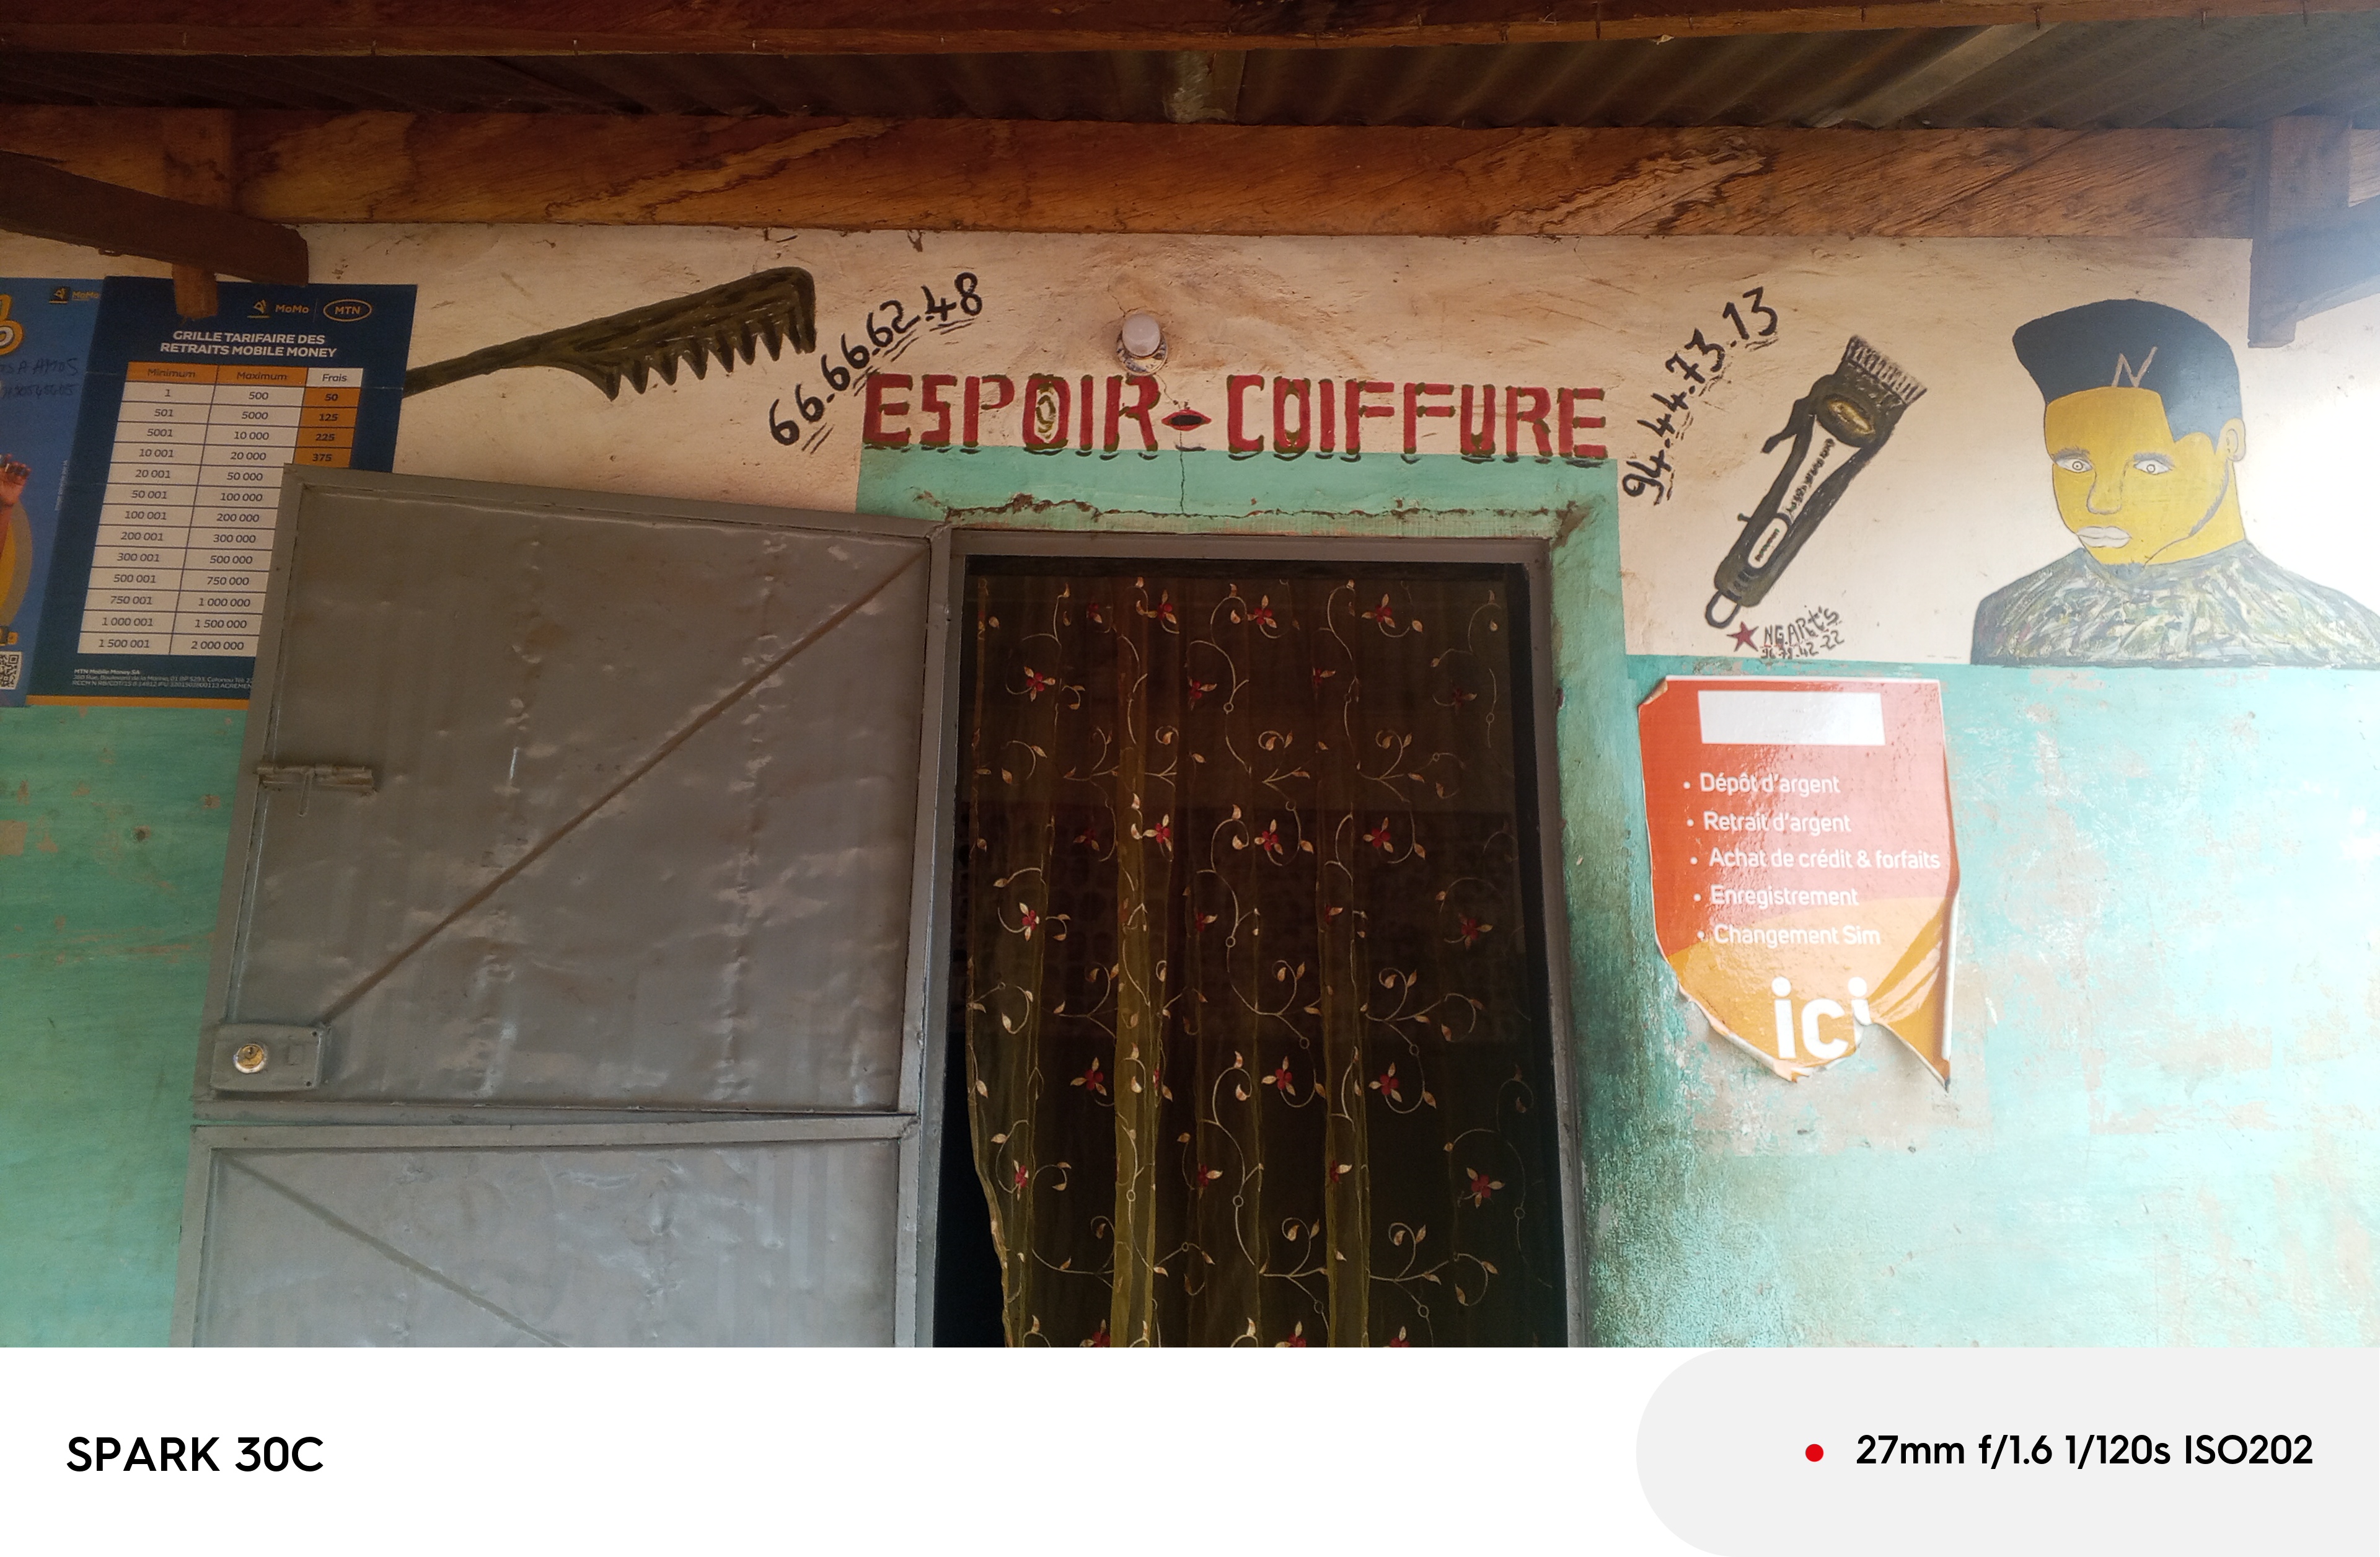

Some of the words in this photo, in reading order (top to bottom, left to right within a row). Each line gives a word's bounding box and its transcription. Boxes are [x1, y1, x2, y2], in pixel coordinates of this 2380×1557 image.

[275, 304, 309, 314] MoMo
[334, 306, 361, 315] MTN
[173, 330, 221, 342] GRILLE
[224, 332, 295, 344] TARIFAIRE
[298, 335, 325, 345] DES
[160, 342, 229, 355] RETRAITS
[231, 345, 284, 356] MOBILE
[286, 347, 337, 358] MONEY
[148, 369, 196, 378] Minimum
[237, 372, 288, 382] Maximum
[322, 374, 347, 382] Frais
[249, 392, 268, 400] 500
[325, 393, 338, 401] 50
[154, 409, 174, 417] 501
[242, 412, 268, 420] 5000
[319, 413, 338, 421] 125
[147, 428, 173, 437] 5001
[234, 431, 247, 440] 10
[249, 431, 269, 440] 000
[315, 433, 335, 442] 225
[139, 449, 152, 457] 10
[154, 449, 174, 457] 001
[230, 452, 244, 461] 20
[245, 452, 267, 461] 000
[312, 454, 332, 462] 375
[135, 469, 149, 479] 20
[151, 469, 170, 479] 001
[227, 472, 240, 481] 50
[242, 472, 263, 481] 000
[131, 490, 146, 499] 50
[148, 490, 167, 499] 001
[220, 493, 240, 501] 100
[242, 493, 263, 501] 000
[125, 511, 145, 520] 100
[147, 511, 167, 520] 001
[216, 513, 237, 523] 200
[239, 513, 259, 523] 000
[121, 532, 141, 541] 200
[143, 532, 164, 541] 001
[213, 534, 234, 543] 300
[236, 534, 256, 543] 000
[117, 553, 138, 562] 300
[139, 553, 159, 562] 001
[209, 555, 231, 564] 500
[232, 555, 253, 564] 000
[113, 574, 134, 583] 500
[136, 574, 156, 583] 001
[207, 576, 227, 585] 750
[229, 576, 249, 585] 000
[111, 596, 130, 605] 750
[132, 596, 152, 605] 001
[198, 598, 204, 606] 1
[208, 598, 228, 607] 000
[230, 598, 250, 607] 000
[102, 617, 108, 625] 1
[111, 617, 131, 627] 000
[133, 617, 153, 627] 001
[195, 619, 200, 628] 1
[204, 620, 224, 629] 500
[226, 620, 247, 629] 000
[99, 639, 104, 647] 1
[107, 639, 128, 647] 500
[130, 640, 149, 648] 001
[191, 641, 198, 649] 2
[201, 641, 221, 649] 000
[223, 642, 244, 650] 000
[1700, 772, 1759, 796] Dépôt
[1761, 773, 1841, 797] d'argent
[1704, 810, 1769, 832] Retrait
[1773, 812, 1851, 837] d'argent
[1709, 847, 1767, 868] Achat
[1771, 849, 1794, 868] de
[1799, 849, 1853, 868] crédit
[1857, 850, 1872, 868] &
[1875, 850, 1941, 869] forfaits
[1711, 884, 1859, 910] Enregistrement
[1714, 924, 1840, 948] Changement
[1843, 925, 1880, 945] Sim
